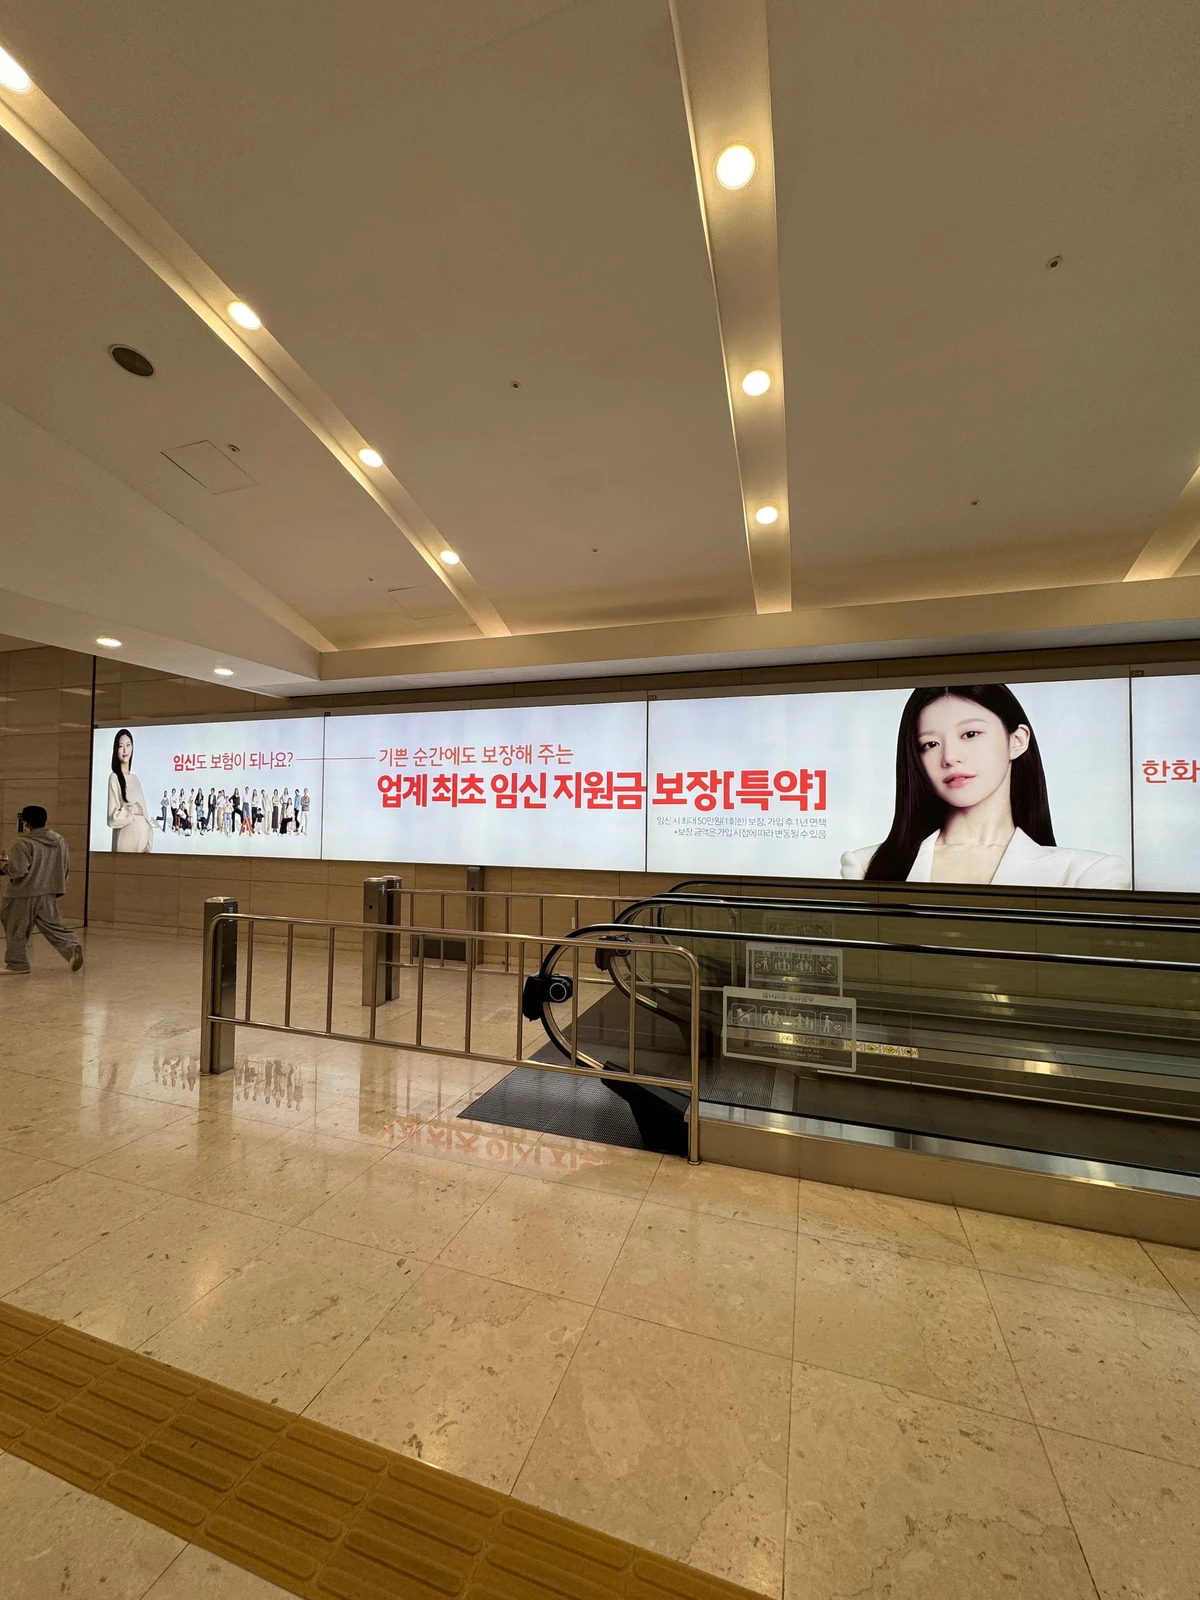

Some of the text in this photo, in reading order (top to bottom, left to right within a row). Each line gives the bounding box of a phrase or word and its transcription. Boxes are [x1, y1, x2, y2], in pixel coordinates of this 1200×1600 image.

[173, 751, 294, 771] 임신도 보험이 되나요?
[379, 744, 574, 767] 기쁜 순간에도 보장해 주는
[1141, 759, 1200, 784] 한화
[377, 773, 428, 808] 업계
[431, 773, 487, 808] 최초
[490, 772, 547, 809] 임신
[553, 771, 647, 809] 지원금
[656, 816, 672, 826] 임신
[767, 817, 784, 827] 가입
[785, 817, 793, 827] 후
[795, 818, 808, 828] 1년
[809, 818, 827, 828] 면책
[716, 828, 734, 838] 가입
[809, 829, 827, 840] 있음
